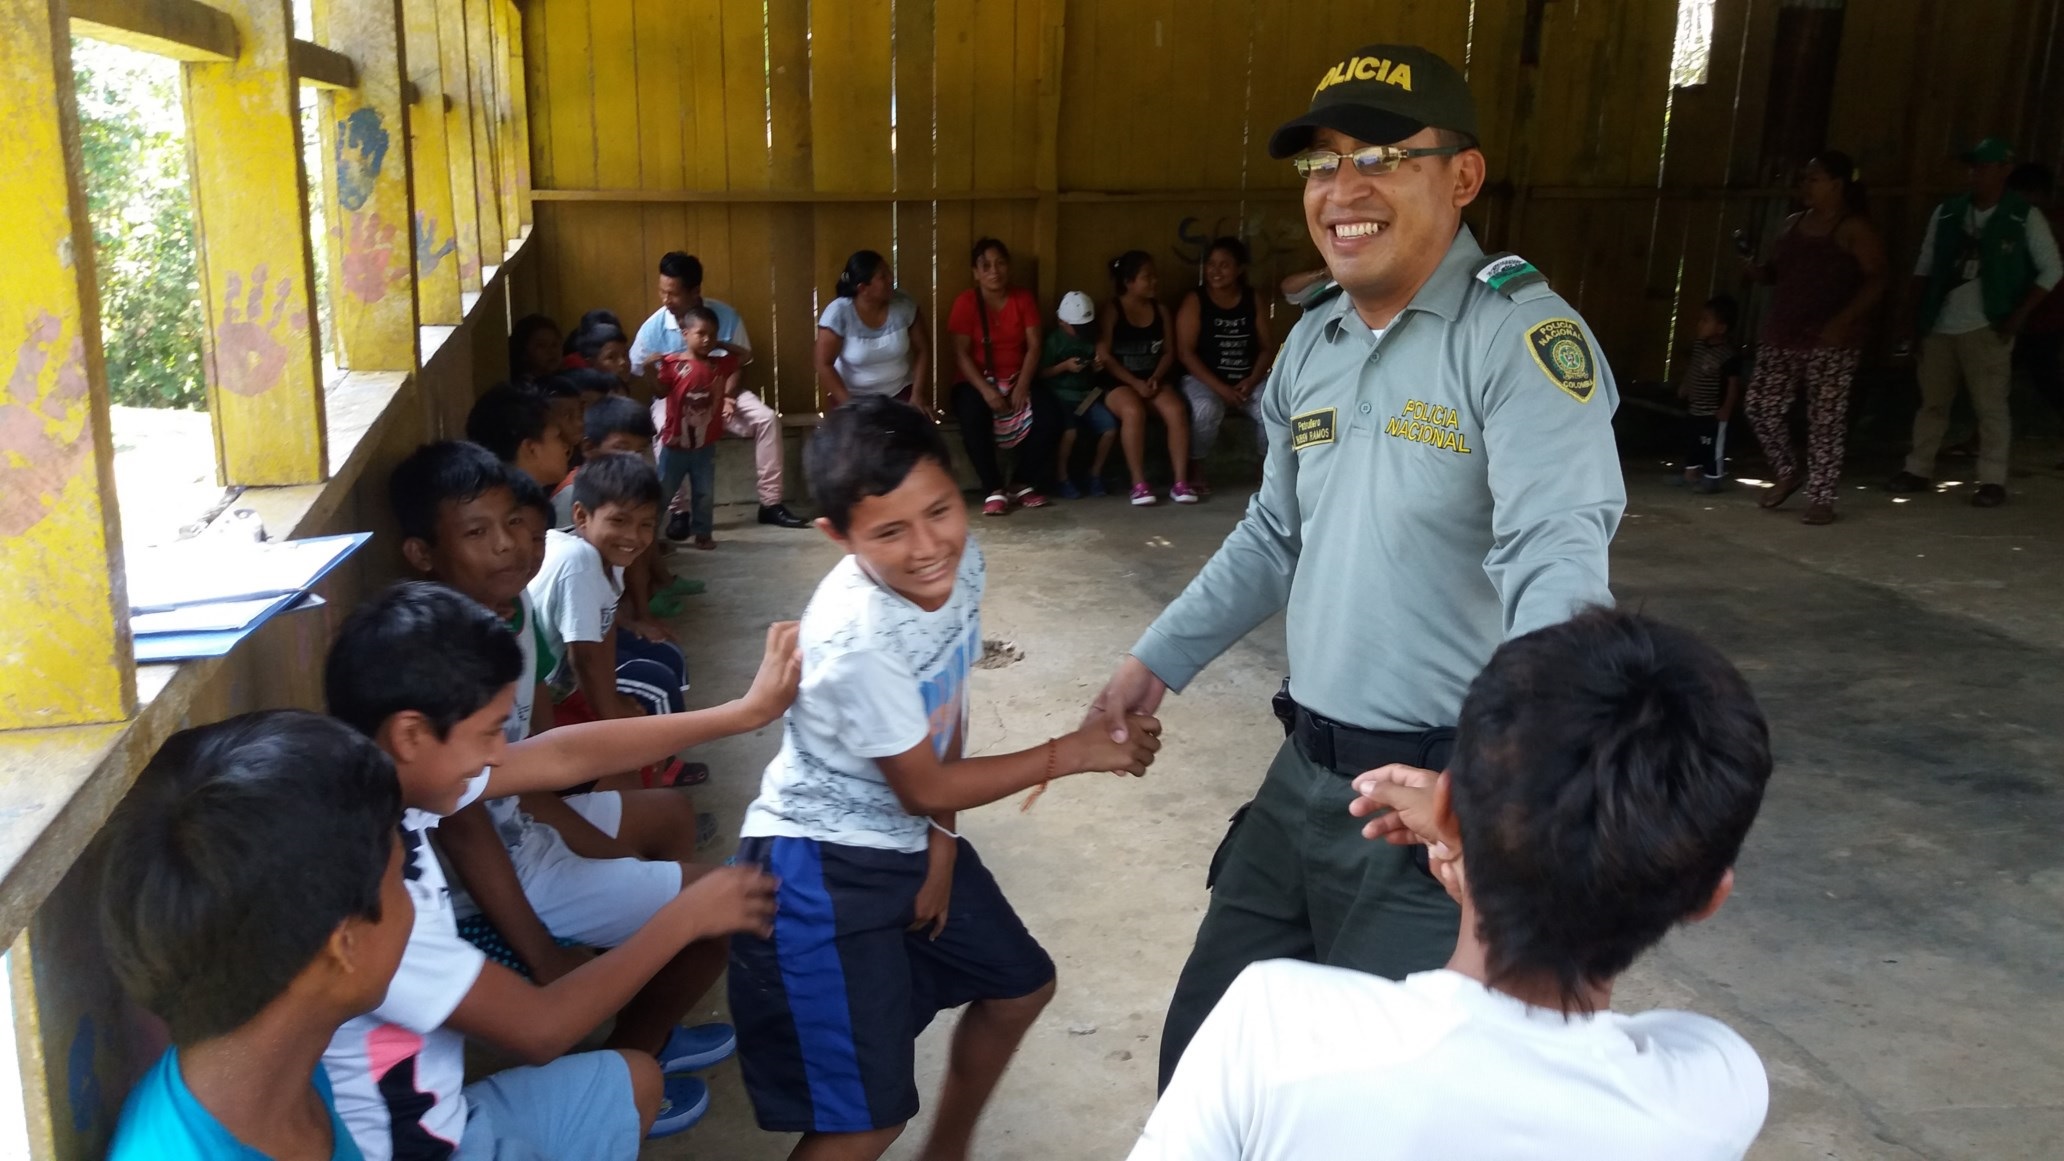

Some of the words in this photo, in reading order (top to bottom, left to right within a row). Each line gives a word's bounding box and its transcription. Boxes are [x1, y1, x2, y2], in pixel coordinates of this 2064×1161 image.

[1538, 328, 1583, 347] NACIONAL
[1539, 321, 1574, 335] POLICIA
[1402, 399, 1460, 430] POLICIA
[1385, 416, 1471, 454] NACIONAL
